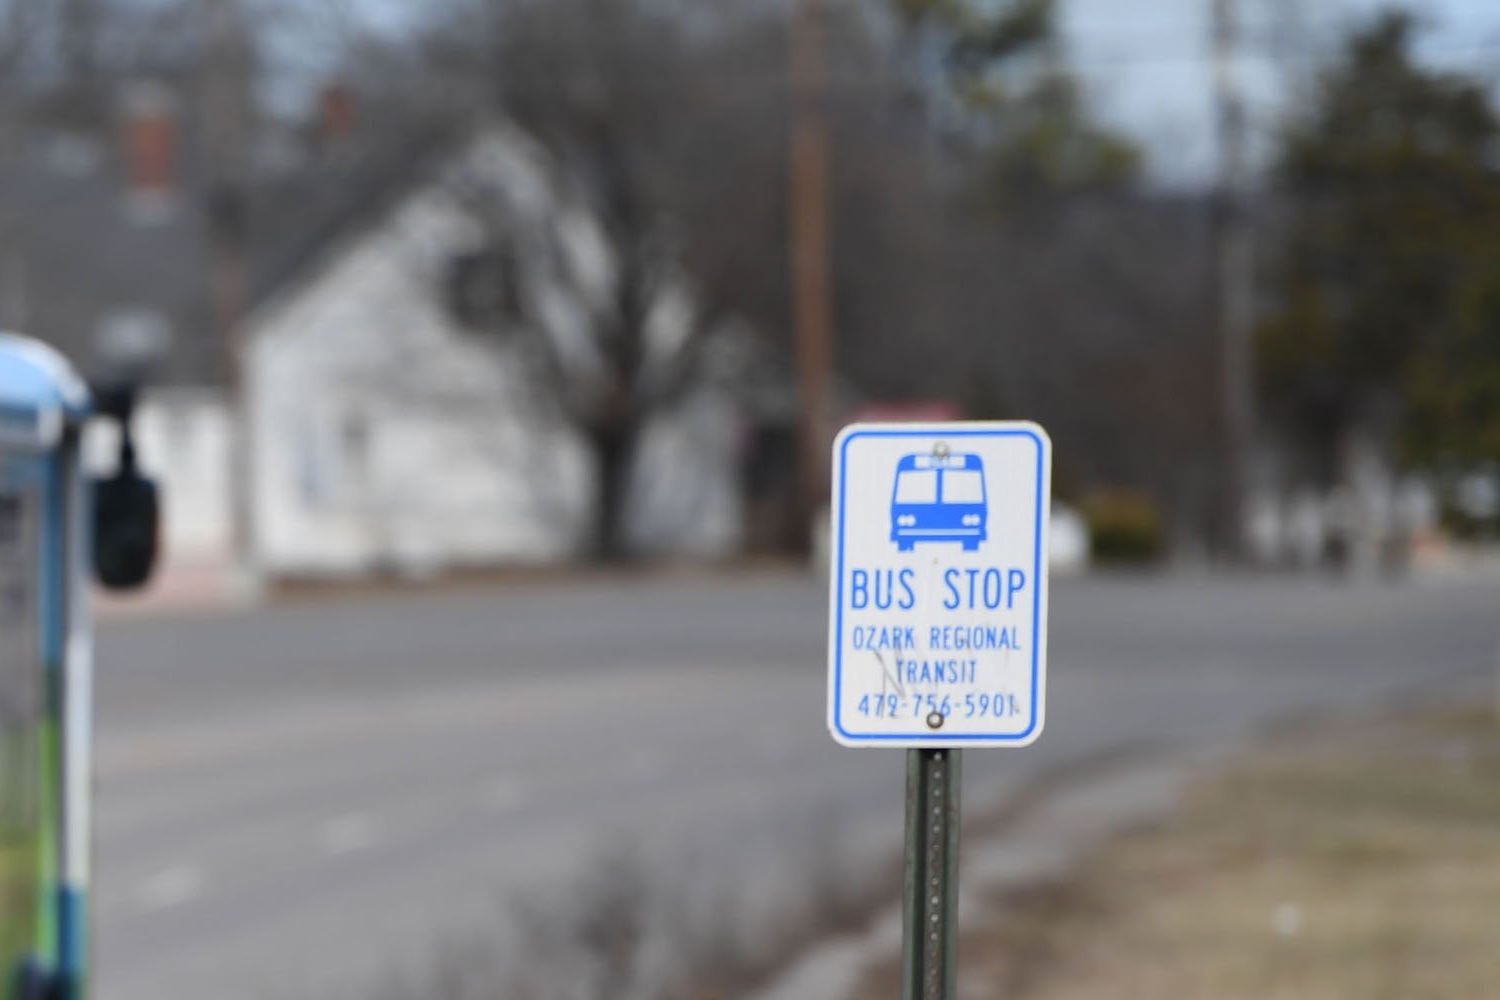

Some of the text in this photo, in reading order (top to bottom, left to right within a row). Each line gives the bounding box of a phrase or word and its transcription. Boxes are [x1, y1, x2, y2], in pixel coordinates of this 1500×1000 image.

[850, 567, 1027, 611] BUS STOP
[851, 625, 1021, 651] OZARK REGIONAL
[896, 658, 978, 684] TRANSIT
[857, 692, 1016, 719] 479-756-5901
